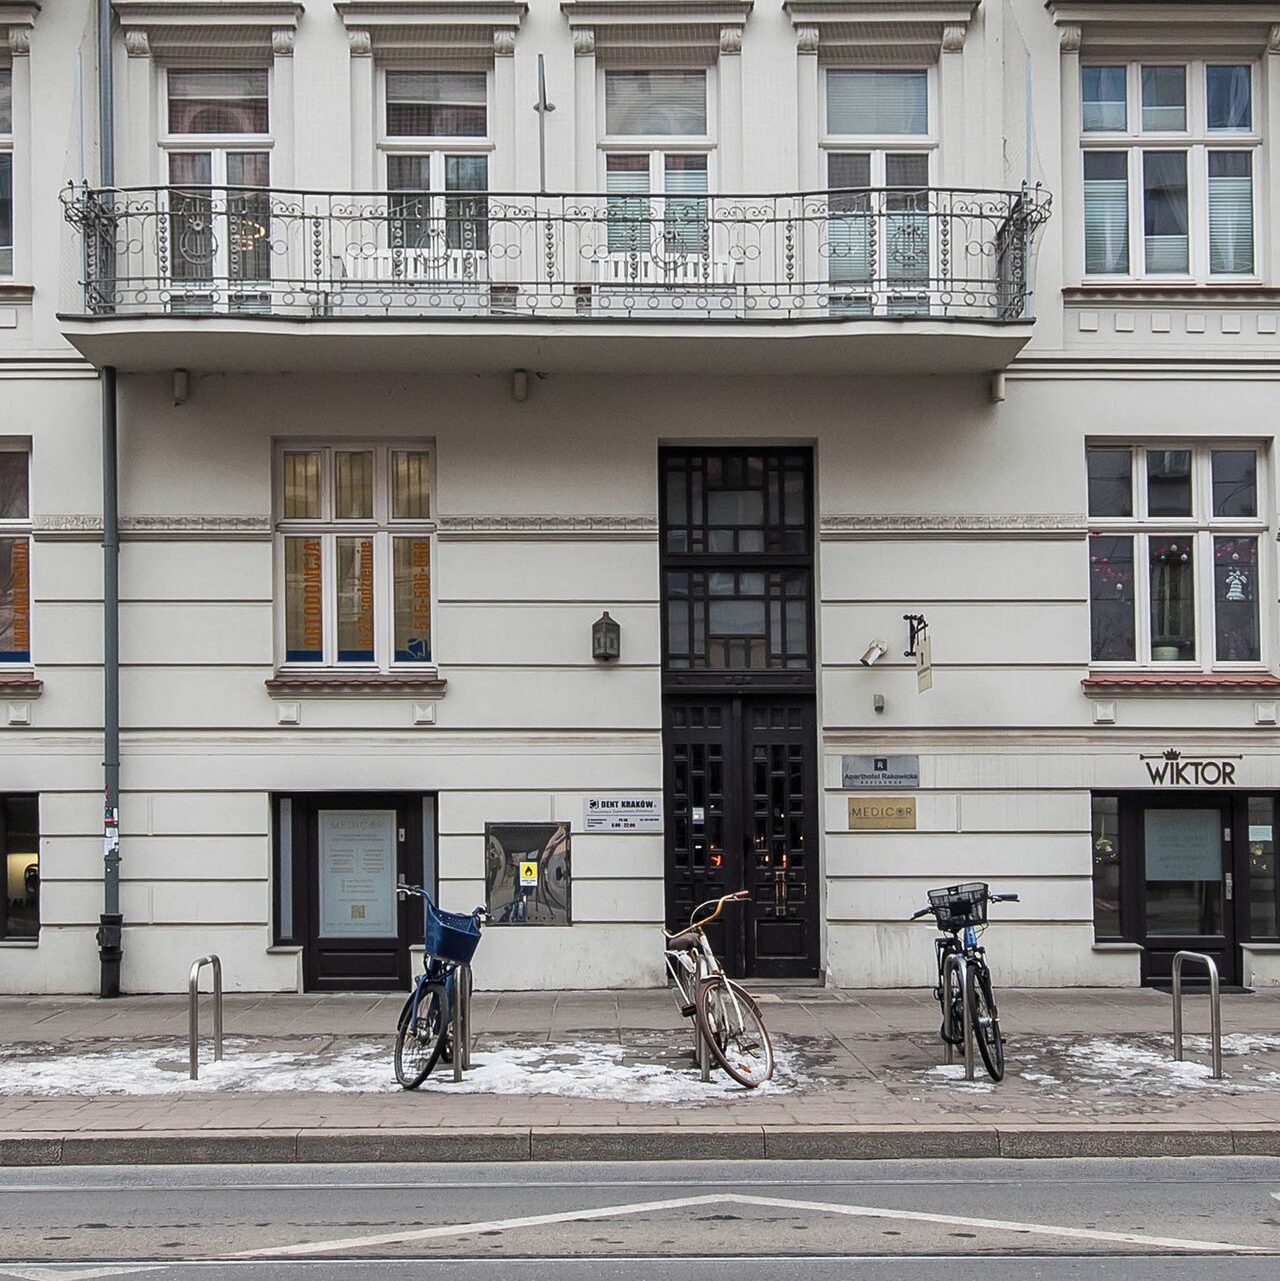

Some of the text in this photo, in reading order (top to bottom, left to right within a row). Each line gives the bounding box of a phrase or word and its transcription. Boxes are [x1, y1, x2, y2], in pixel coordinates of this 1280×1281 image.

[356, 540, 372, 612] codziennie
[303, 540, 320, 648] ORTODONCJA
[1145, 761, 1236, 785] WIKTOR
[601, 799, 654, 808] DENT KRAKÓW
[852, 807, 912, 817] MEDICOR
